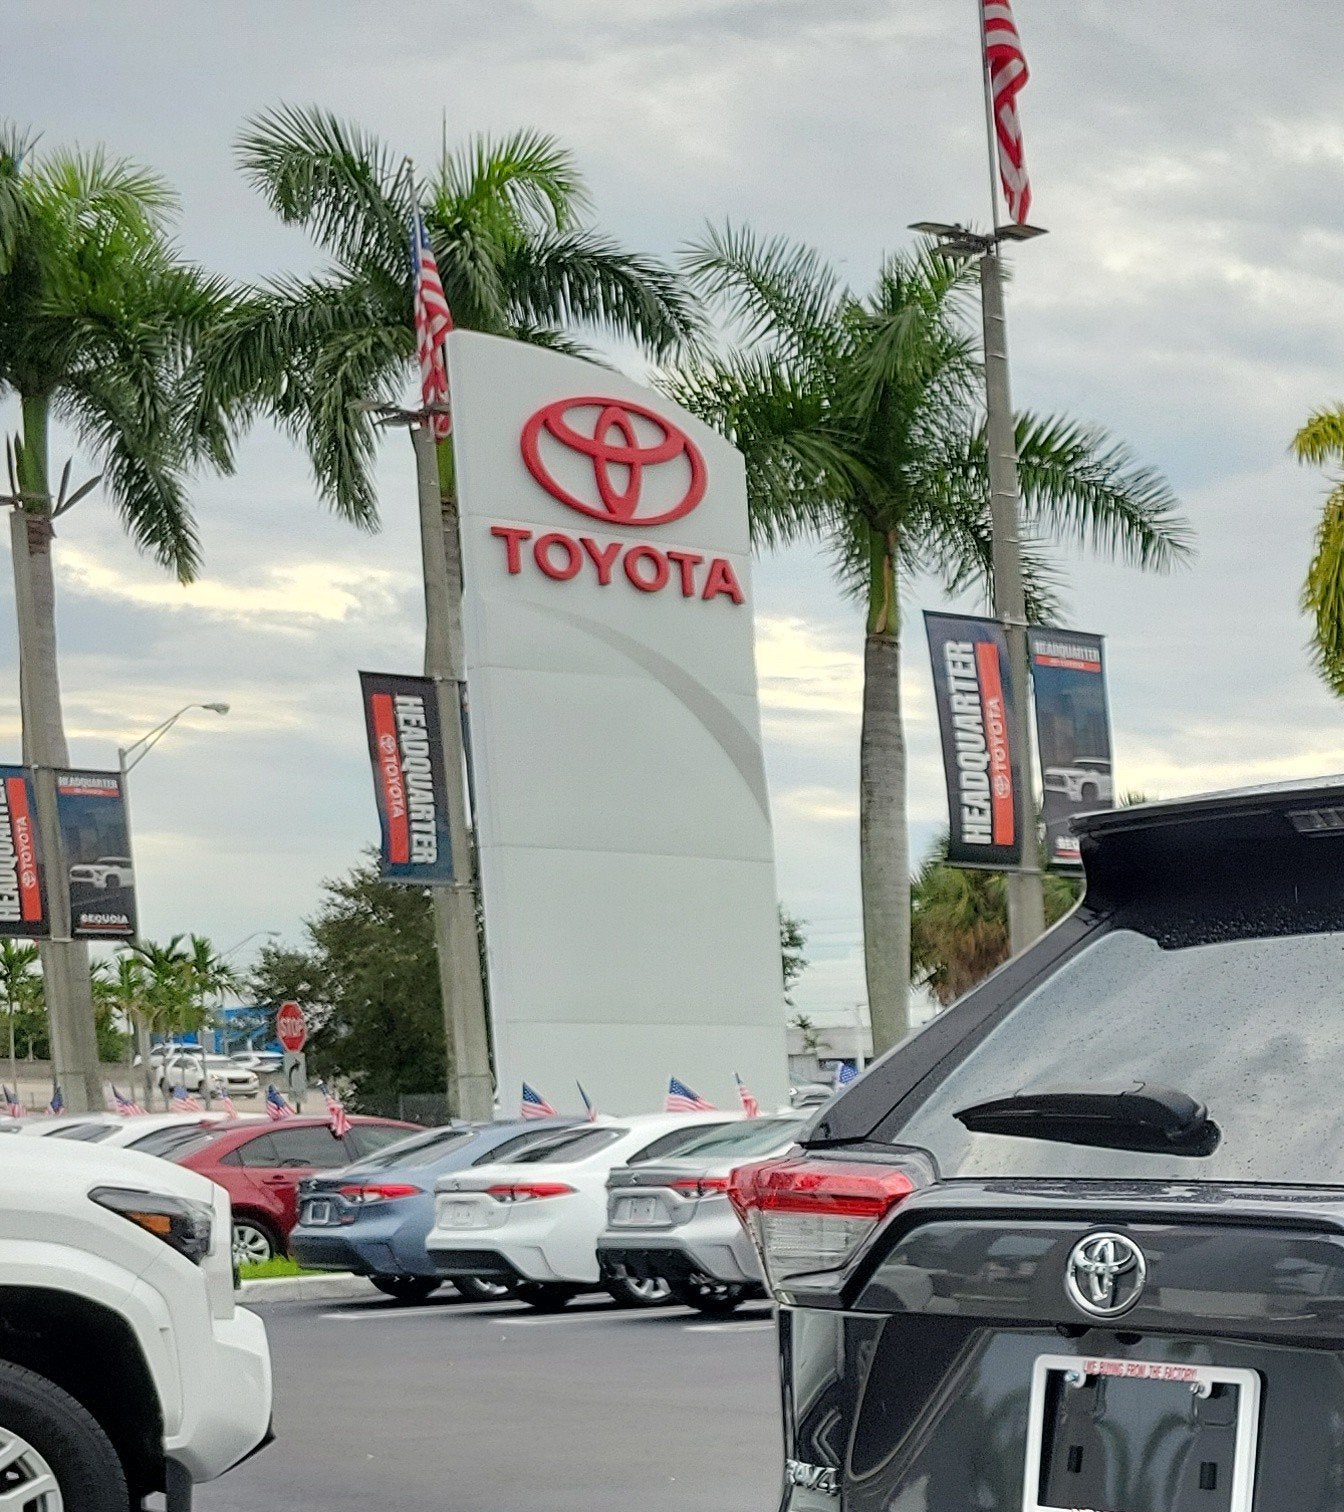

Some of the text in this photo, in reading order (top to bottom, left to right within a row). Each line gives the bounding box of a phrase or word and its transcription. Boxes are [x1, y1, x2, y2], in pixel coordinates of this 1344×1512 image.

[490, 526, 746, 604] TOYOTA
[946, 641, 992, 844] HEADQUARTER
[988, 698, 1008, 773] TOYOTA
[382, 753, 404, 817] TOYOTA
[395, 694, 438, 863] HEADQUARTER
[16, 816, 34, 869] TOYOTA
[80, 913, 130, 925] SEQUOIA
[279, 1016, 306, 1038] STOP
